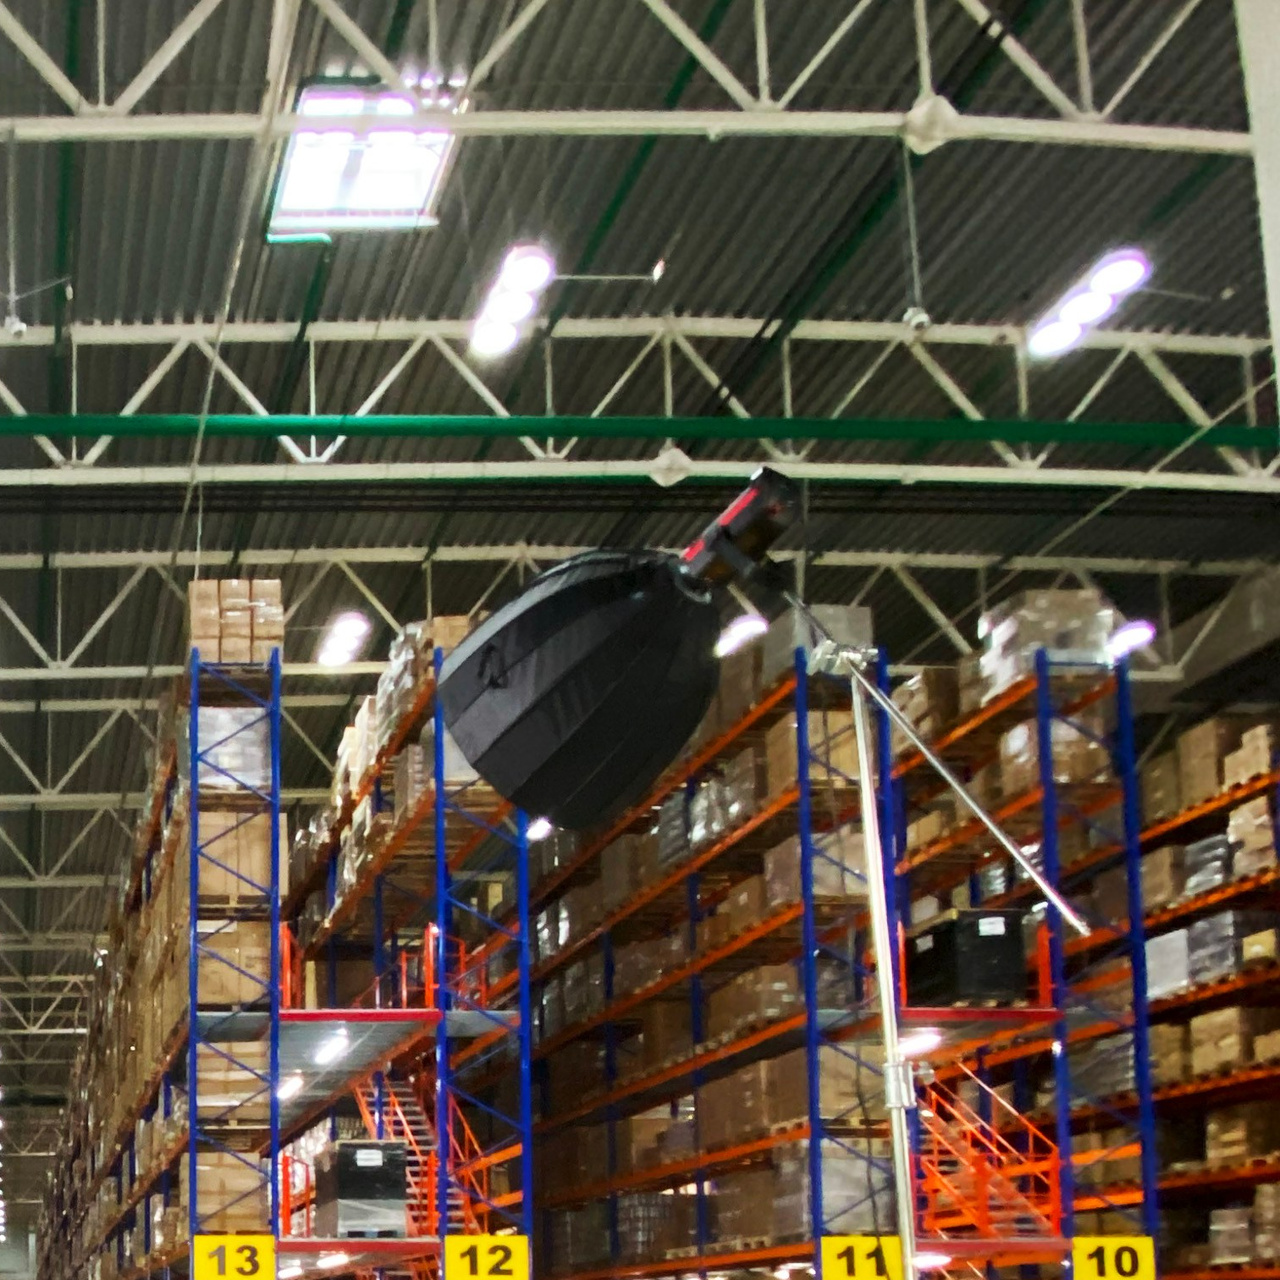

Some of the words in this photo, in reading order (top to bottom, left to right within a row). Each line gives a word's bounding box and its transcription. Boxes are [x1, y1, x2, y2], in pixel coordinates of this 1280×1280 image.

[207, 1245, 260, 1276] 13
[461, 1245, 512, 1276] 12
[836, 1245, 888, 1278] 11
[1087, 1246, 1139, 1278] 10
